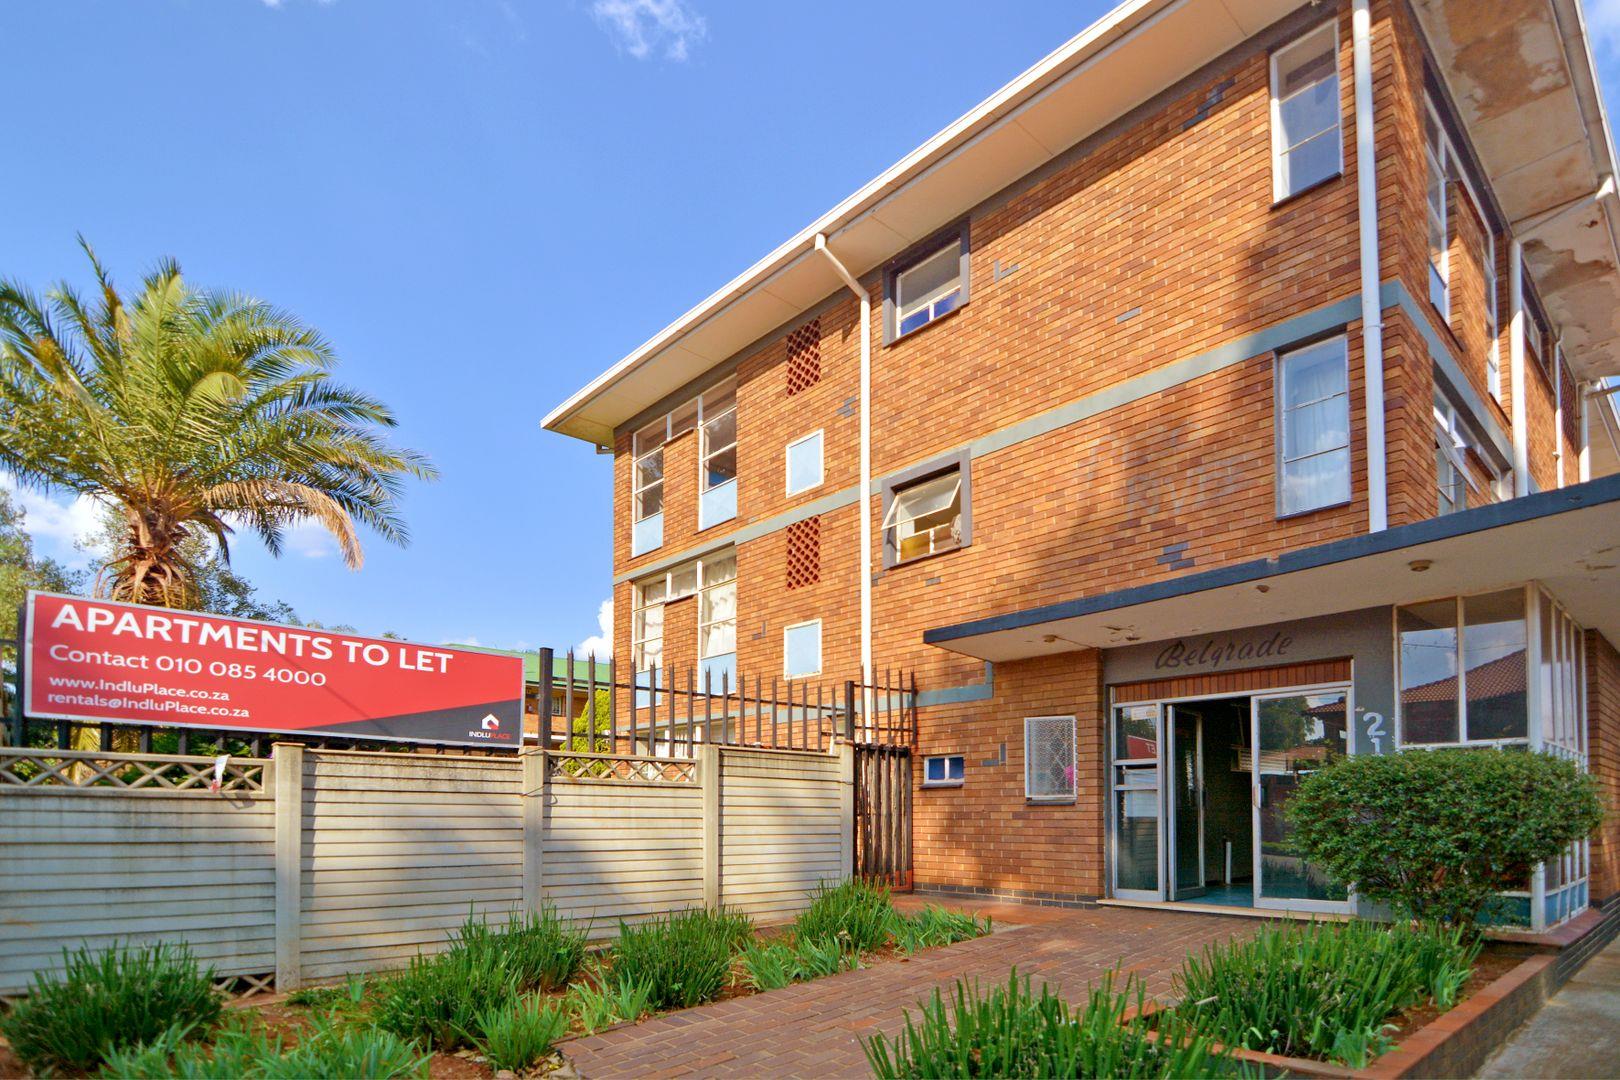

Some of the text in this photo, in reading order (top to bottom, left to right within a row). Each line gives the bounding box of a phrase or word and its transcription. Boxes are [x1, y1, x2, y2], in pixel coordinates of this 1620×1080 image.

[51, 603, 453, 673] APARTMENTS TO LET
[1155, 631, 1292, 670] Belgrade
[50, 644, 326, 686] Contact 010 085 4000
[47, 692, 250, 718] rentals@IndluPlace.co.za
[48, 676, 230, 701] www.IndluPlace.co.za
